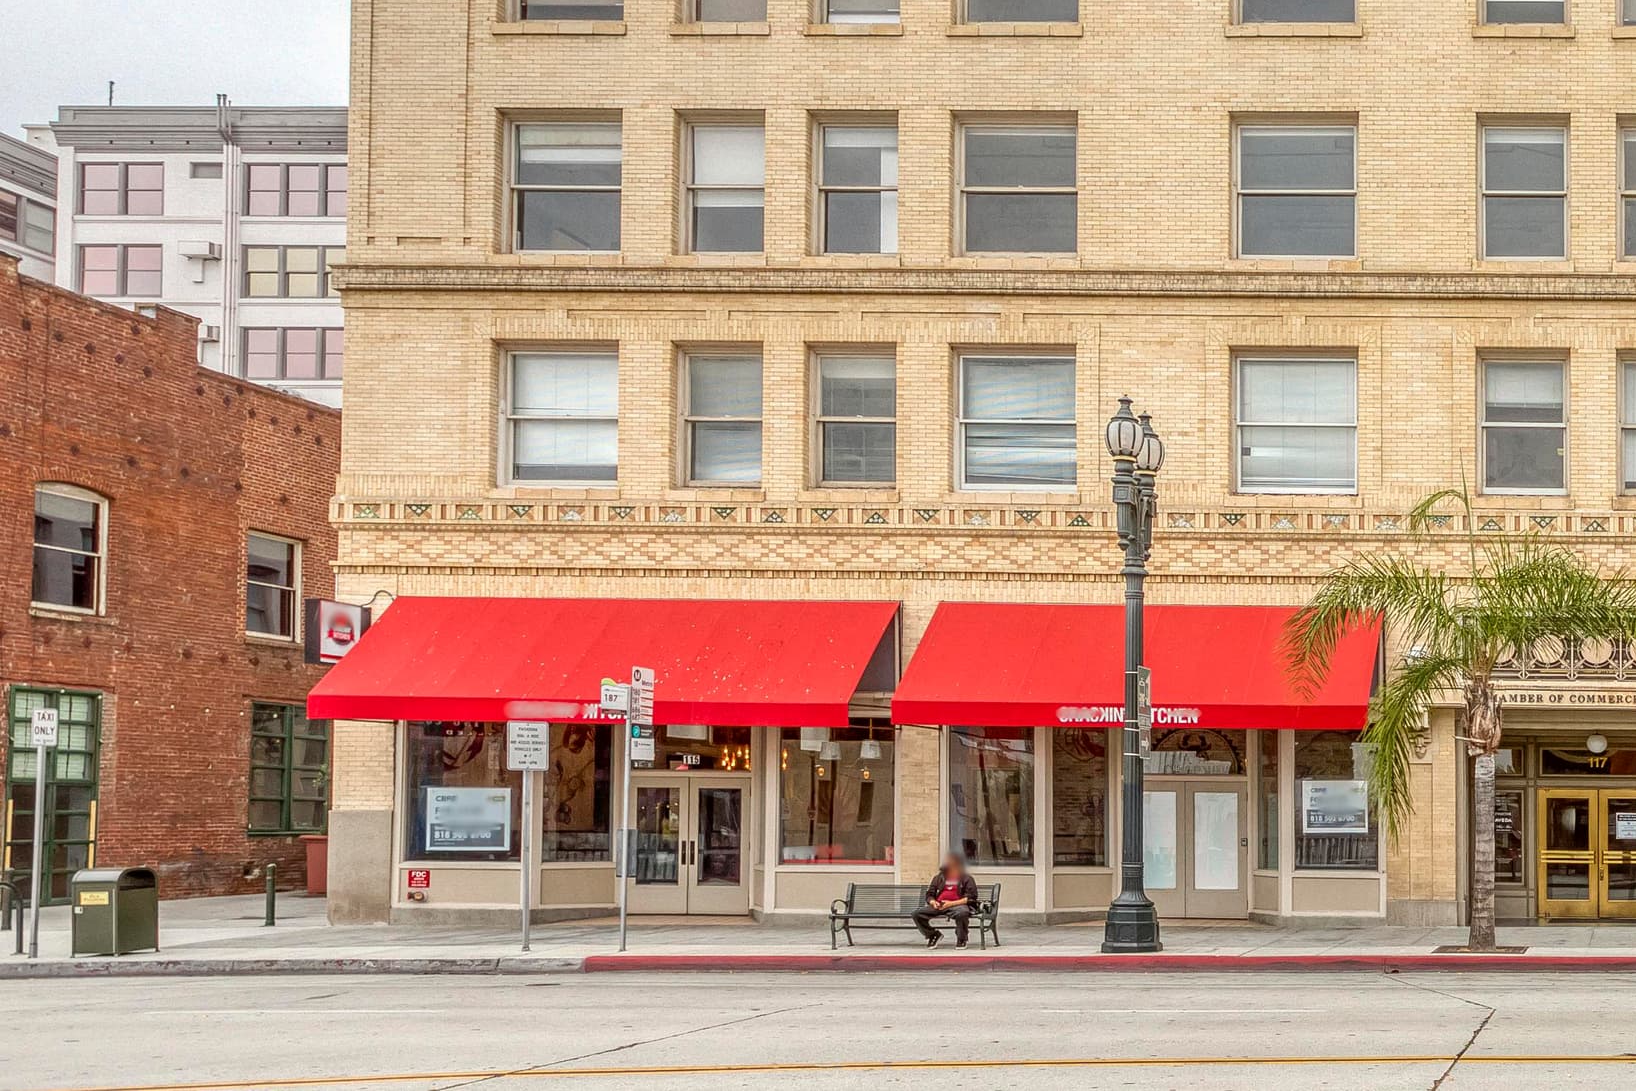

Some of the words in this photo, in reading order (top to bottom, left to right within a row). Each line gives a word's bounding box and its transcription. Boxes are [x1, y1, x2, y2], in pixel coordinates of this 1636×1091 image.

[604, 693, 618, 702] 187
[1548, 694, 1564, 704] OF
[36, 712, 55, 721] TAXI
[35, 725, 55, 735] ONLY
[683, 755, 700, 764] 115
[1588, 757, 1608, 768] 117
